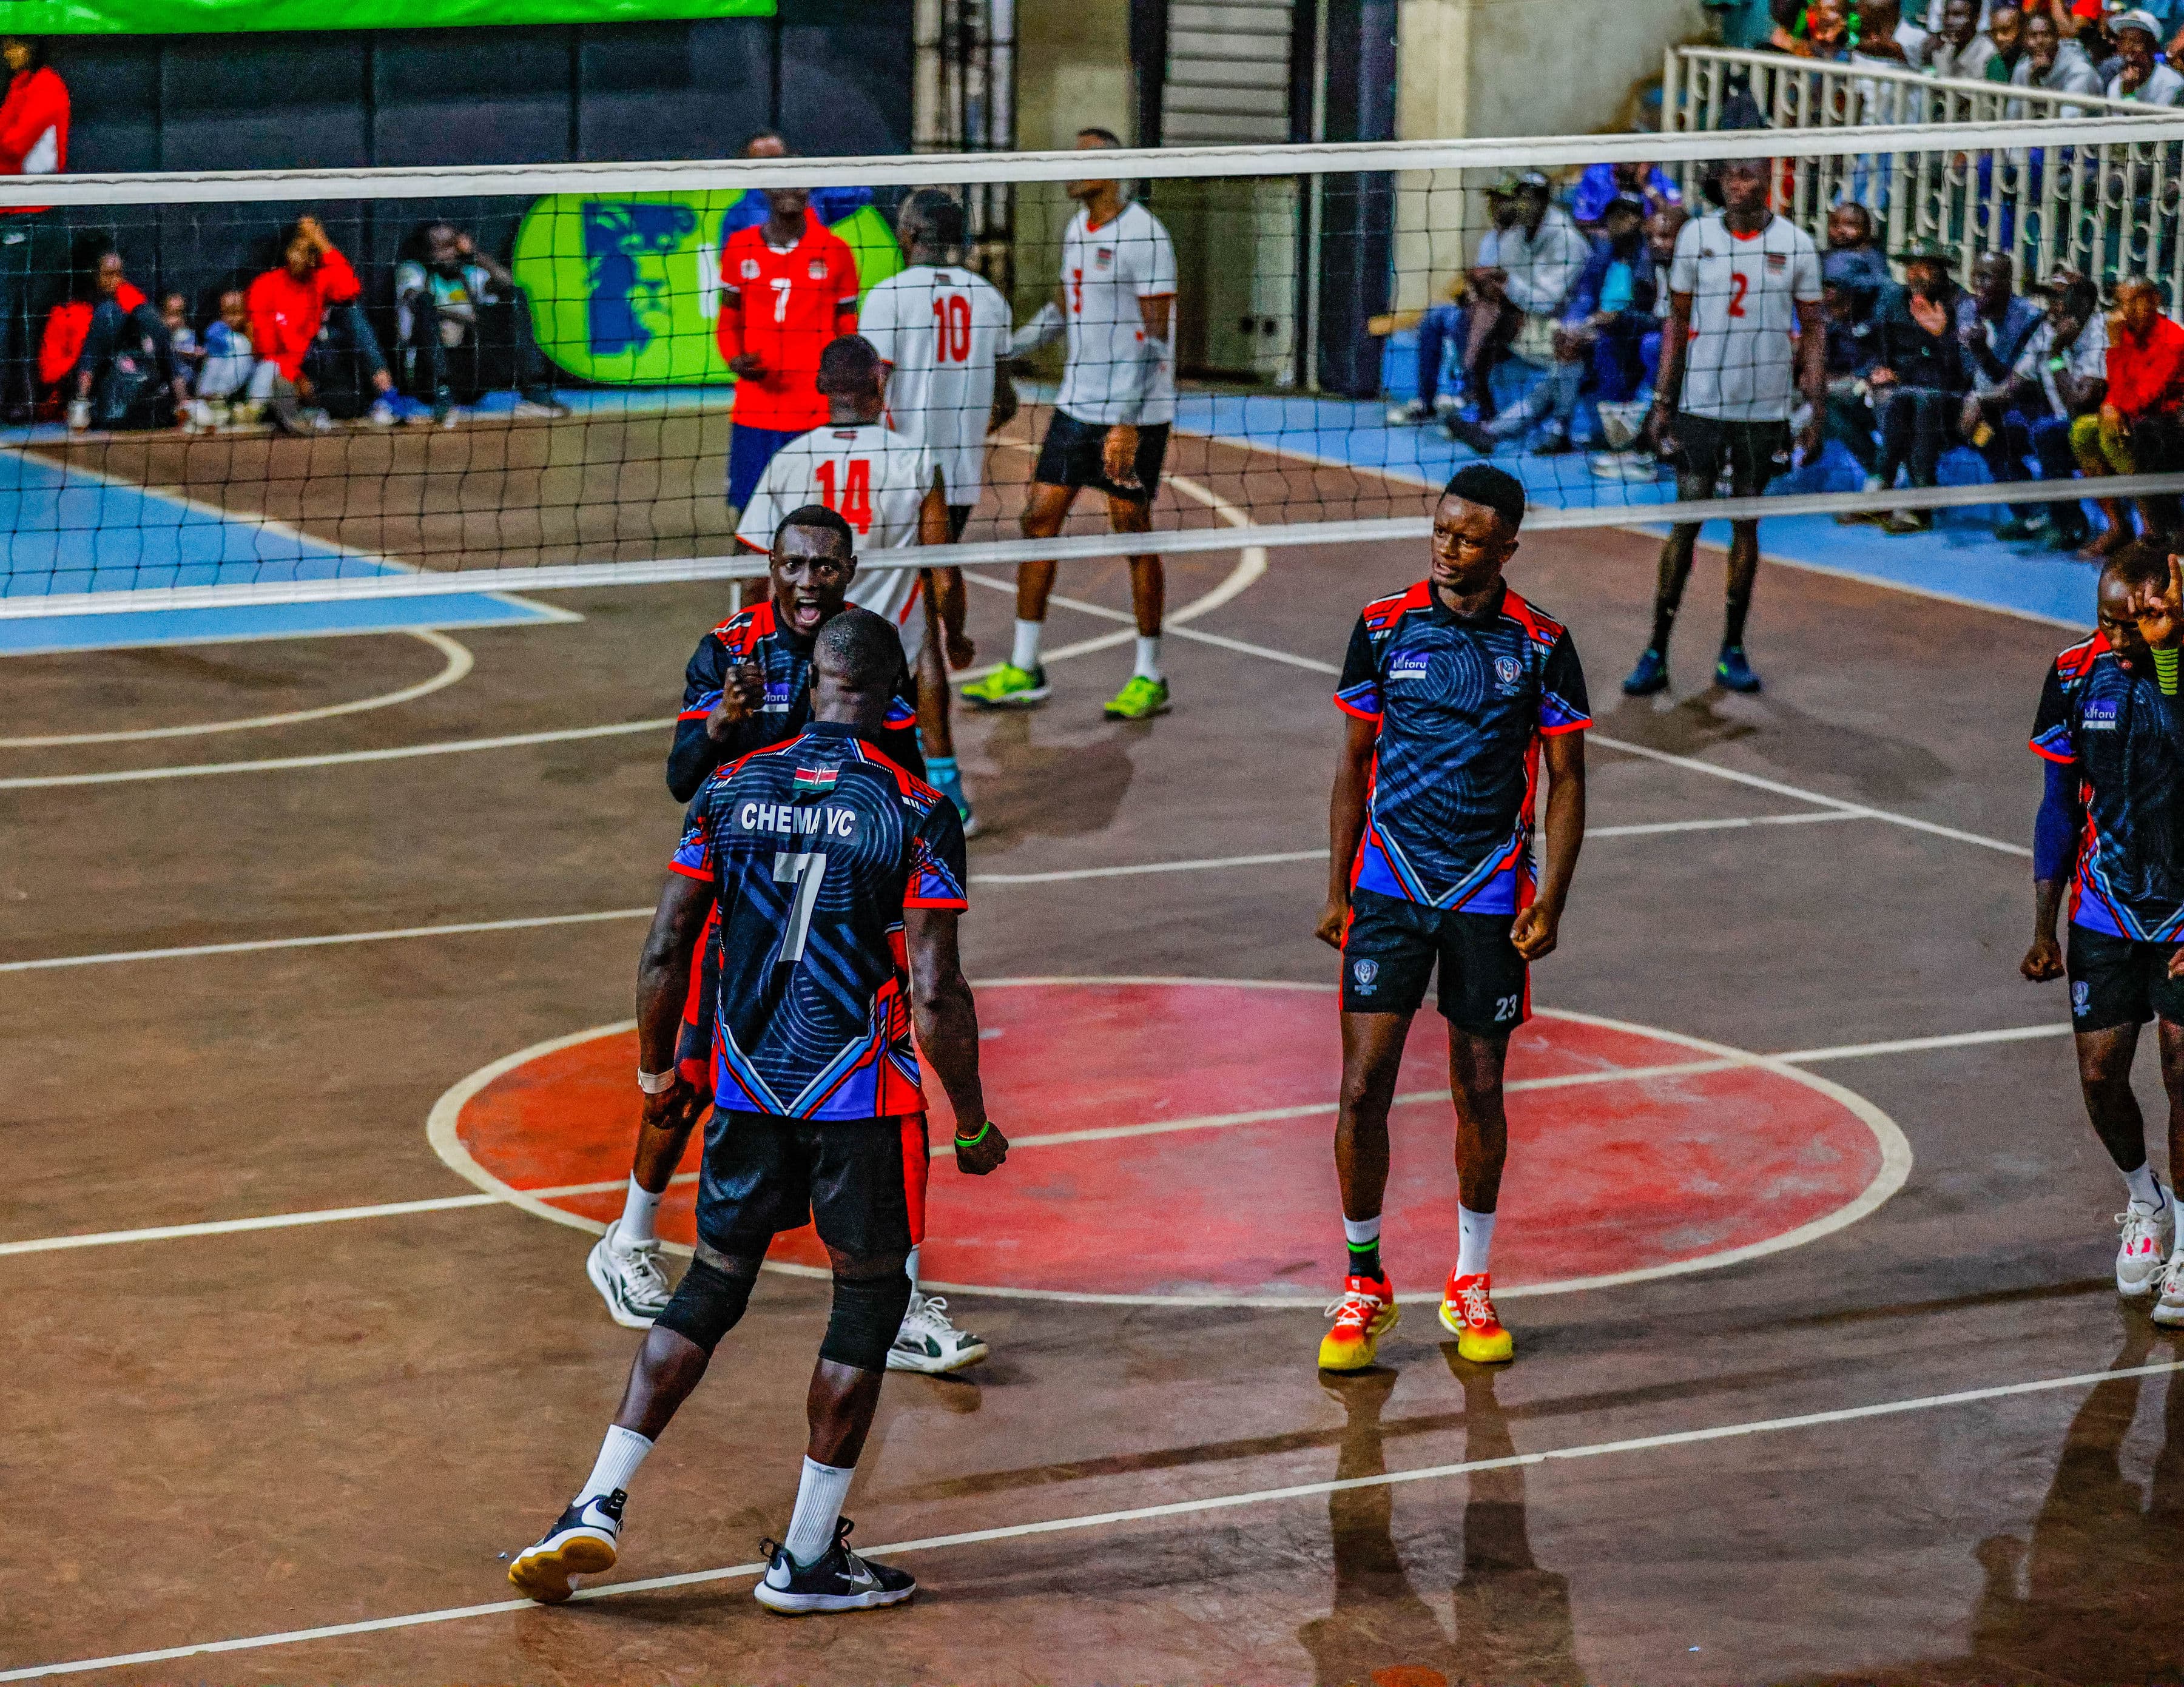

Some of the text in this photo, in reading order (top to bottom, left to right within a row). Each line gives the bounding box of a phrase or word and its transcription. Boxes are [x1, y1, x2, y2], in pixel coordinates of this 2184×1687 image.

[770, 278, 792, 323] 7
[1728, 272, 1747, 317] 2
[933, 294, 971, 363] 10
[815, 459, 872, 535] 14
[826, 807, 855, 837] VC
[773, 852, 826, 961] 7
[1494, 994, 1517, 1022] 23
